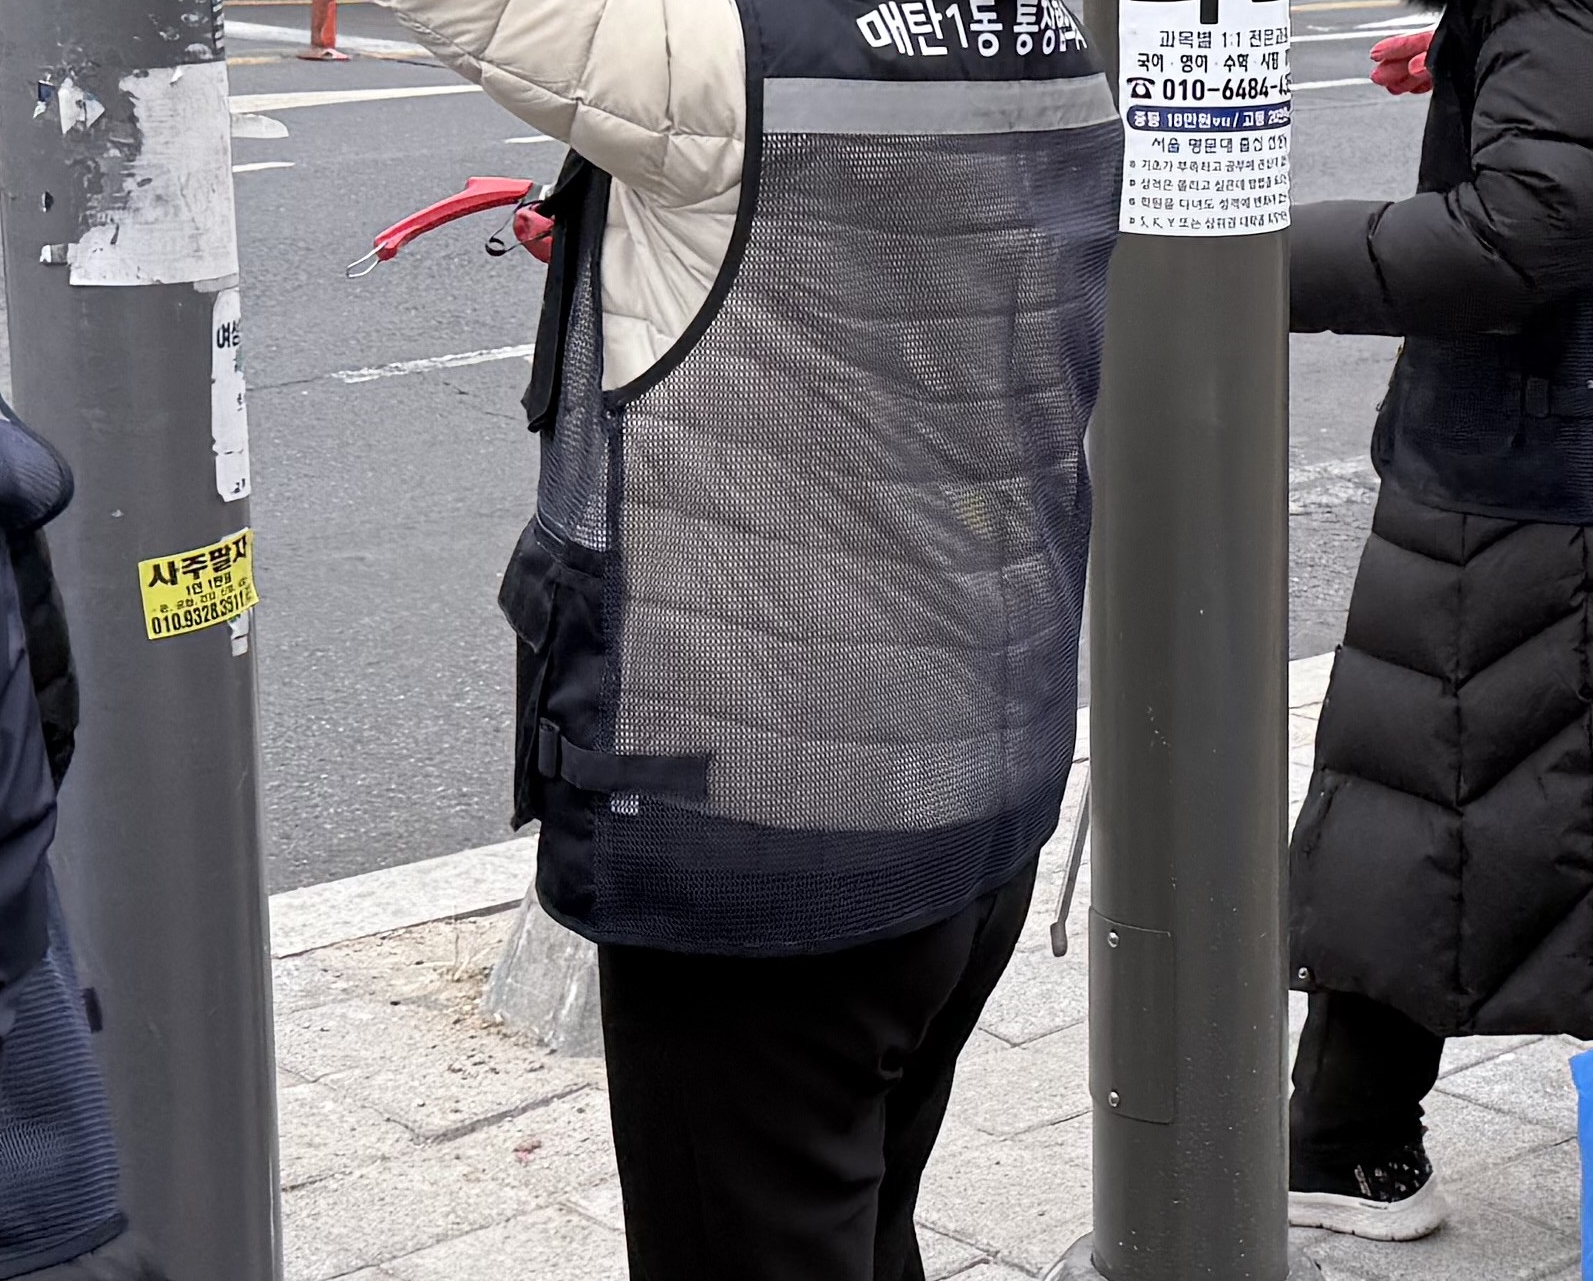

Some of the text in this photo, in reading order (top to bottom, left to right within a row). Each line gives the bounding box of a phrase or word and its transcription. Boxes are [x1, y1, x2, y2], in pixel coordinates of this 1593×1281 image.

[1159, 30, 1212, 49] 과목별
[1221, 31, 1242, 49] 1:1
[1137, 52, 1164, 73] 국어
[1180, 52, 1209, 74] 영어
[1223, 52, 1250, 73] 수학
[148, 534, 248, 588] 사주팔자
